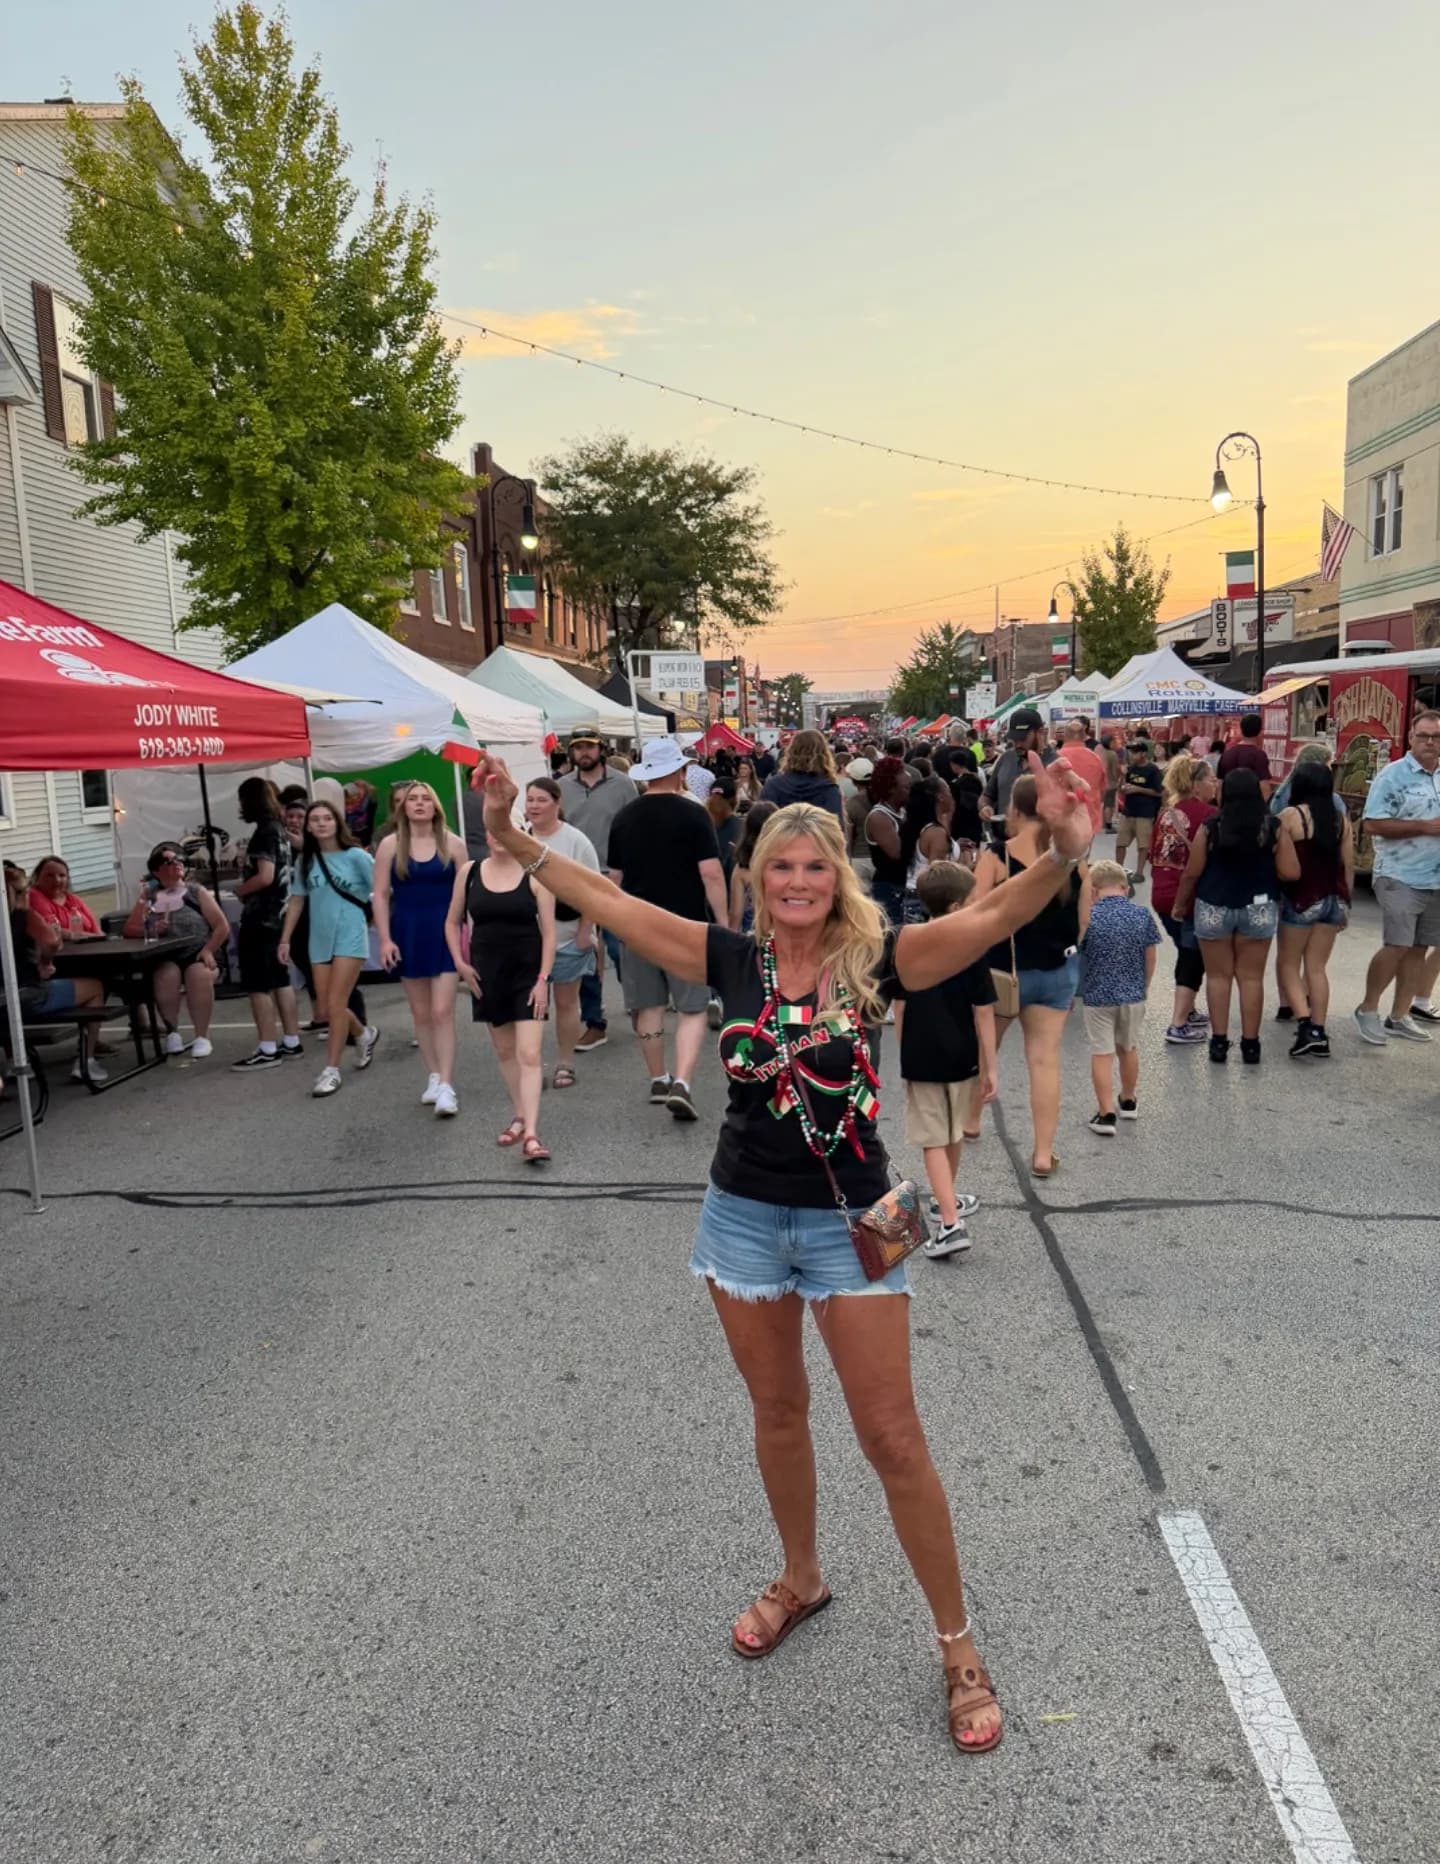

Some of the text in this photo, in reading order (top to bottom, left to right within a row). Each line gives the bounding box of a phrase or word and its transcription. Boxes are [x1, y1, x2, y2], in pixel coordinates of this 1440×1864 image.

[1216, 603, 1227, 647] BOOTS
[1148, 689, 1215, 697] Rotary
[134, 704, 219, 727] JODY WHITE
[1111, 701, 1162, 715] COLLINSVILLE
[1168, 699, 1210, 713] MARYVILLE
[138, 736, 224, 759] 618-343-1400
[752, 1028, 831, 1082] ITAIAN
